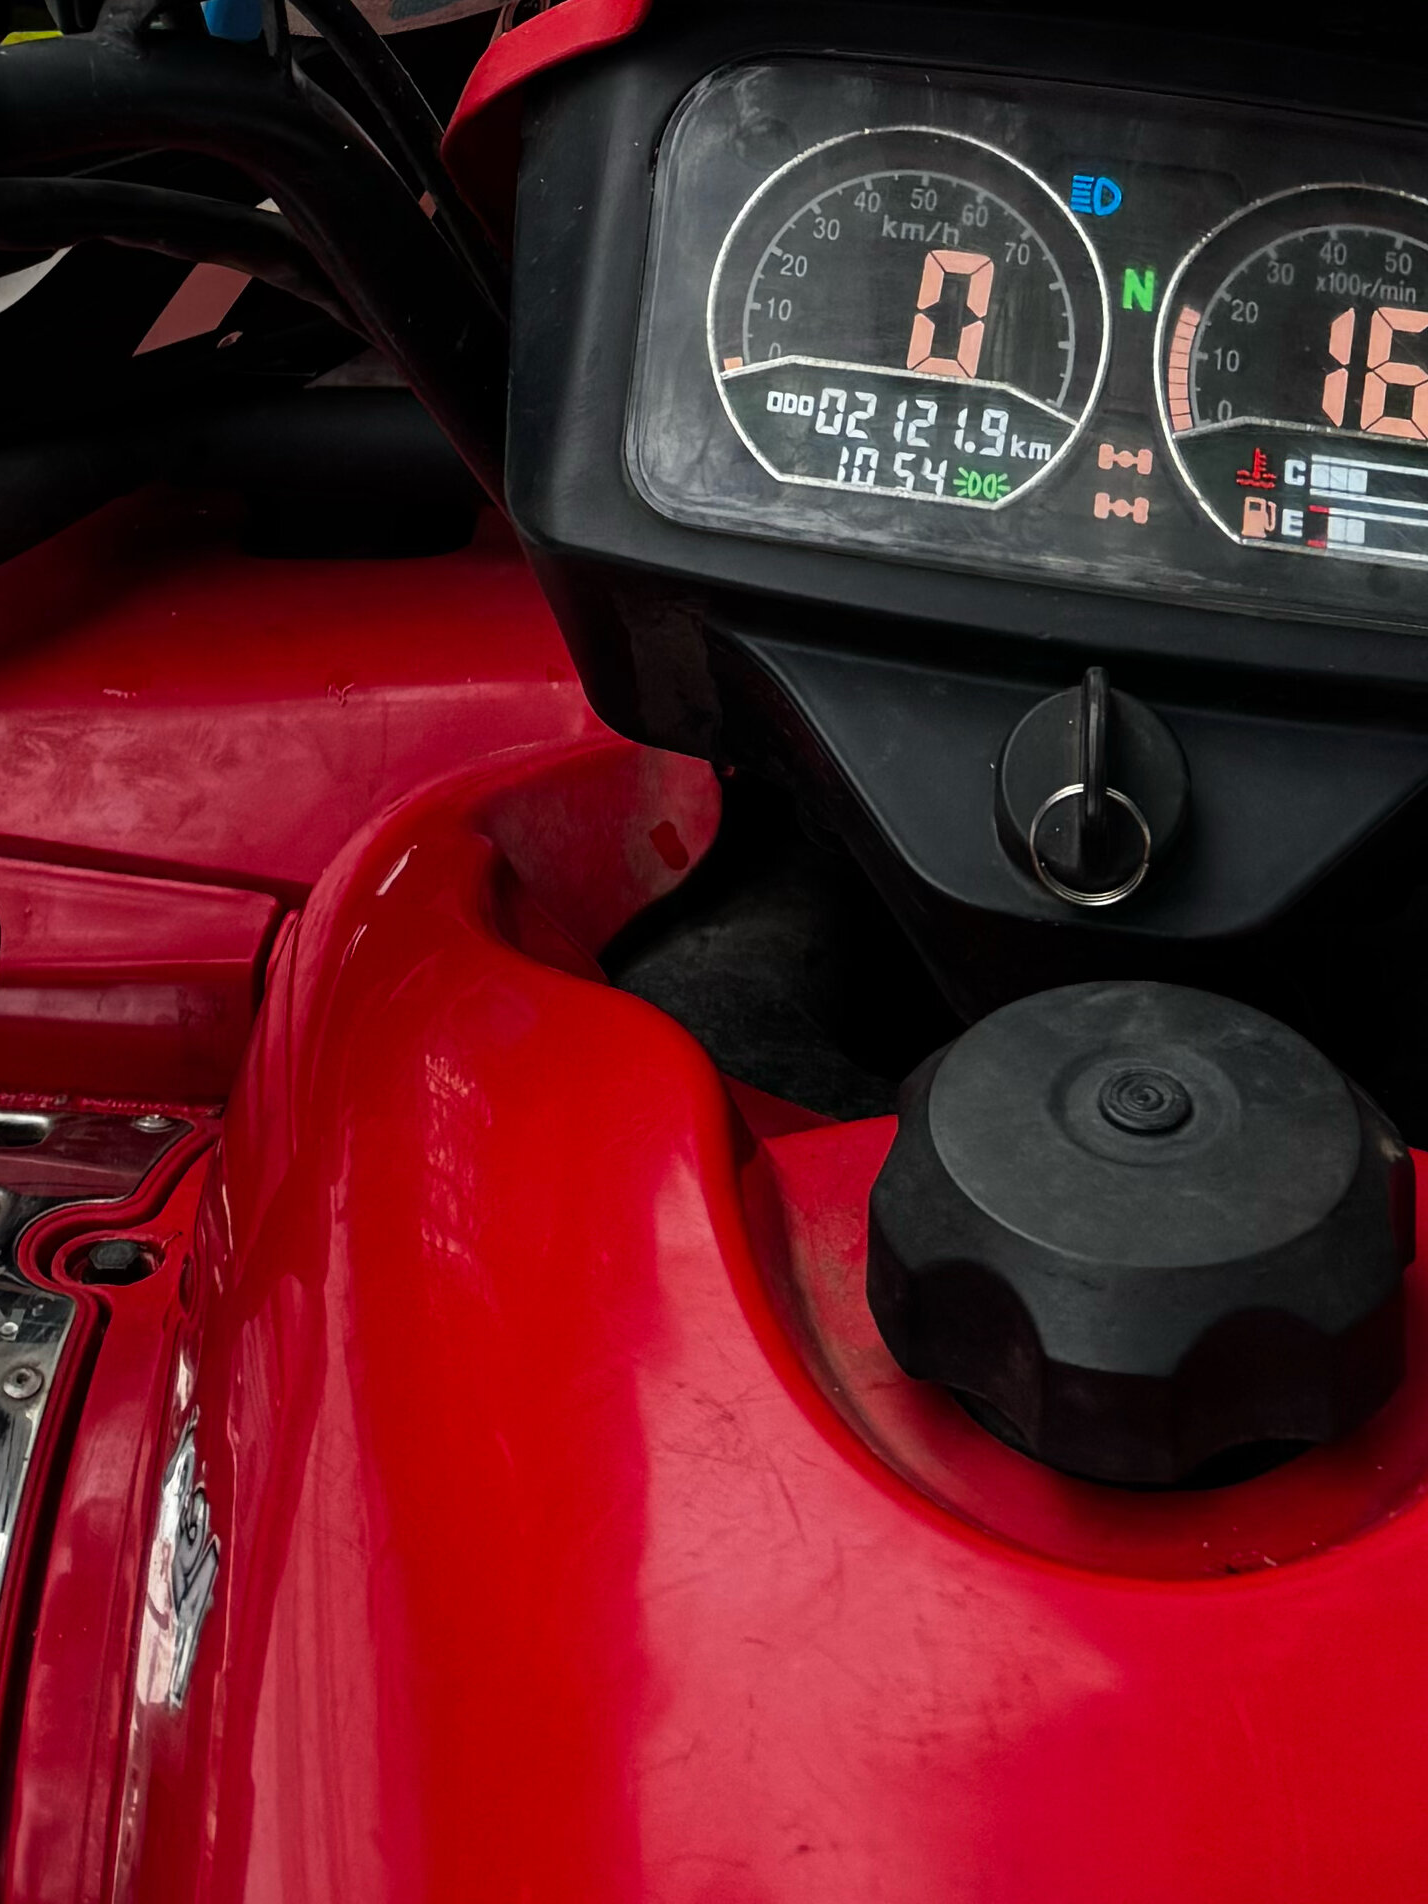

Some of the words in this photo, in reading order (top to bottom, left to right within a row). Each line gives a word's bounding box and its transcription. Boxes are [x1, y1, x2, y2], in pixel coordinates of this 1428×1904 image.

[854, 191, 881, 214] 40
[910, 188, 937, 212] 50
[961, 204, 989, 228] 60
[812, 218, 841, 241] 30
[882, 214, 959, 245] km/h
[1003, 241, 1030, 266] 70
[1320, 243, 1347, 266] 40
[1384, 251, 1413, 274] 50
[780, 255, 808, 278] 20
[1266, 263, 1295, 285] 30
[1122, 267, 1156, 312] N
[1316, 271, 1417, 304] x100r/min
[767, 298, 792, 321] 10
[907, 250, 995, 379] 0
[1230, 300, 1259, 324] 20
[1213, 349, 1240, 372] 10
[1218, 400, 1233, 421] 0
[767, 391, 814, 416] ODO
[1010, 434, 1051, 461] km
[1284, 459, 1306, 485] C
[1281, 508, 1304, 537] E
